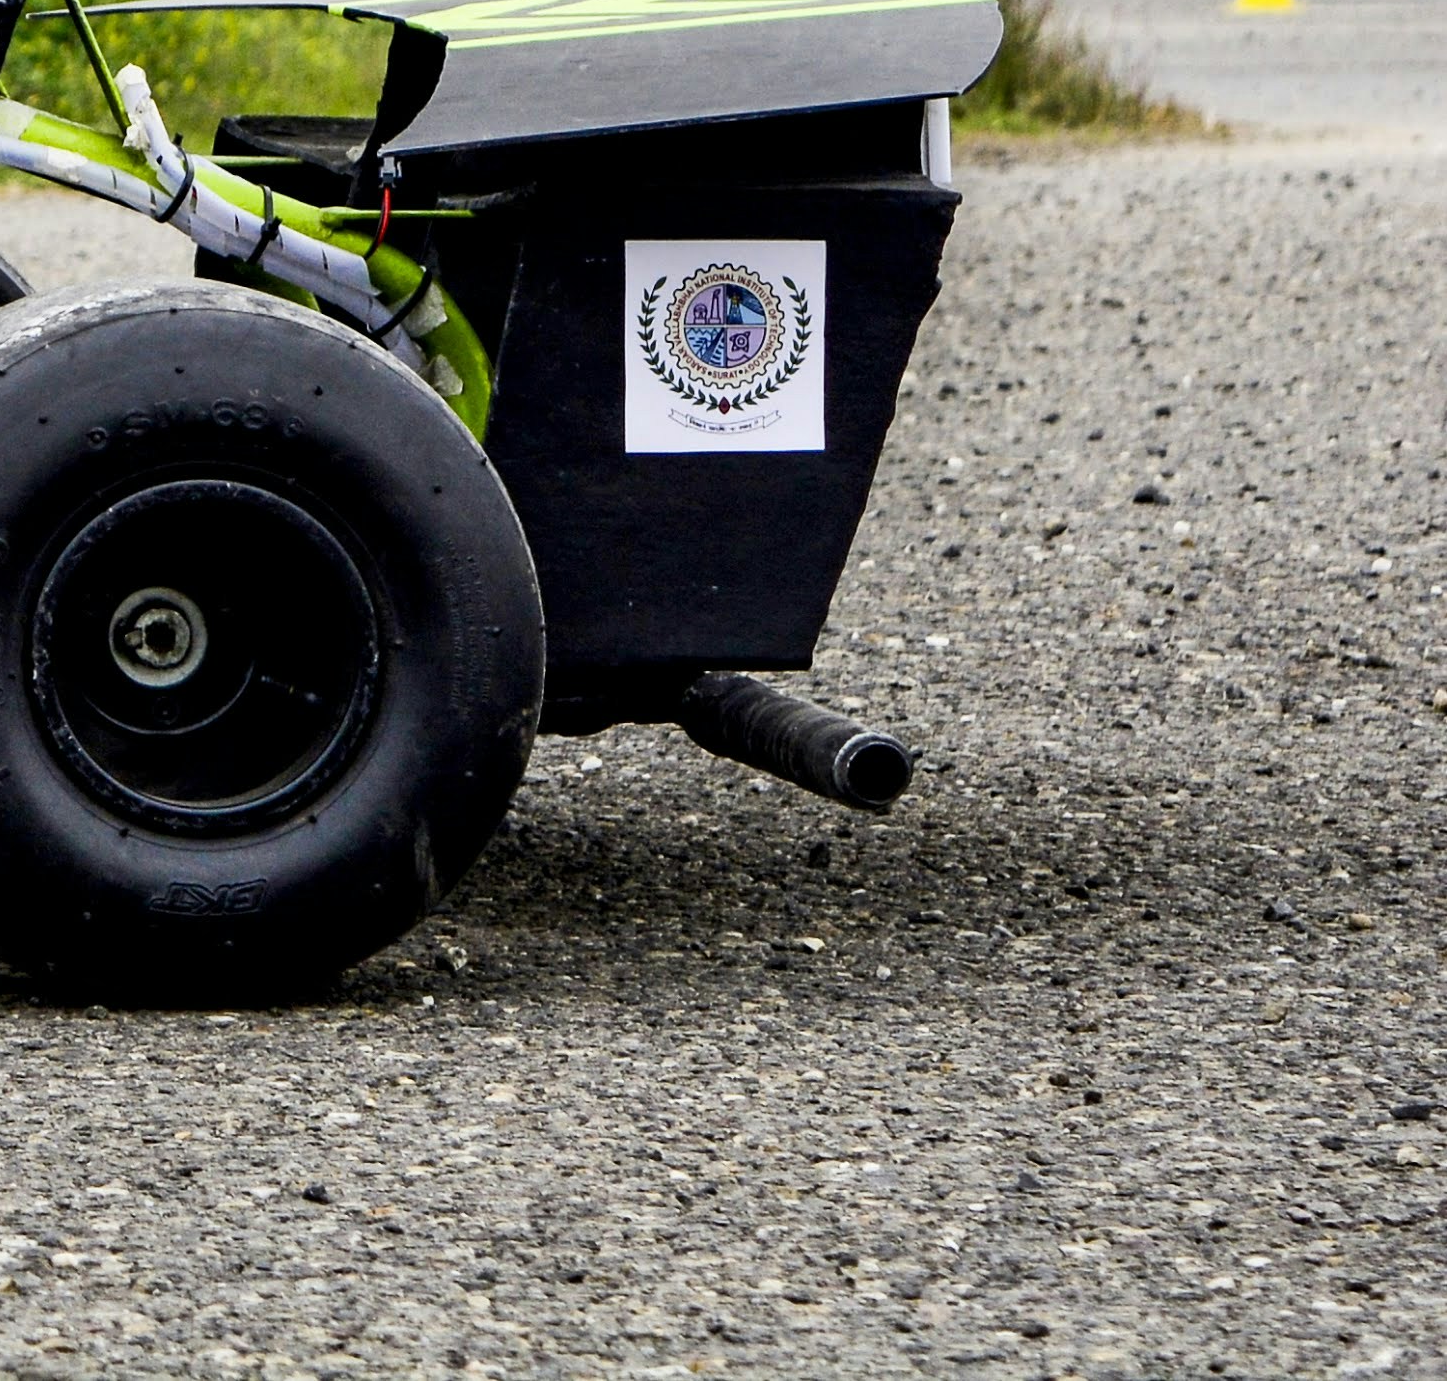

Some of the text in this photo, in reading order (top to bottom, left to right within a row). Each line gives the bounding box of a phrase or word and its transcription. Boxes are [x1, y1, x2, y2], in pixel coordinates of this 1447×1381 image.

[694, 273, 735, 288] NATIONAL
[737, 275, 773, 307] INSTITUTE
[768, 308, 777, 321] OF
[743, 323, 778, 375] TECHNOLOGY
[712, 371, 738, 379] SURAT
